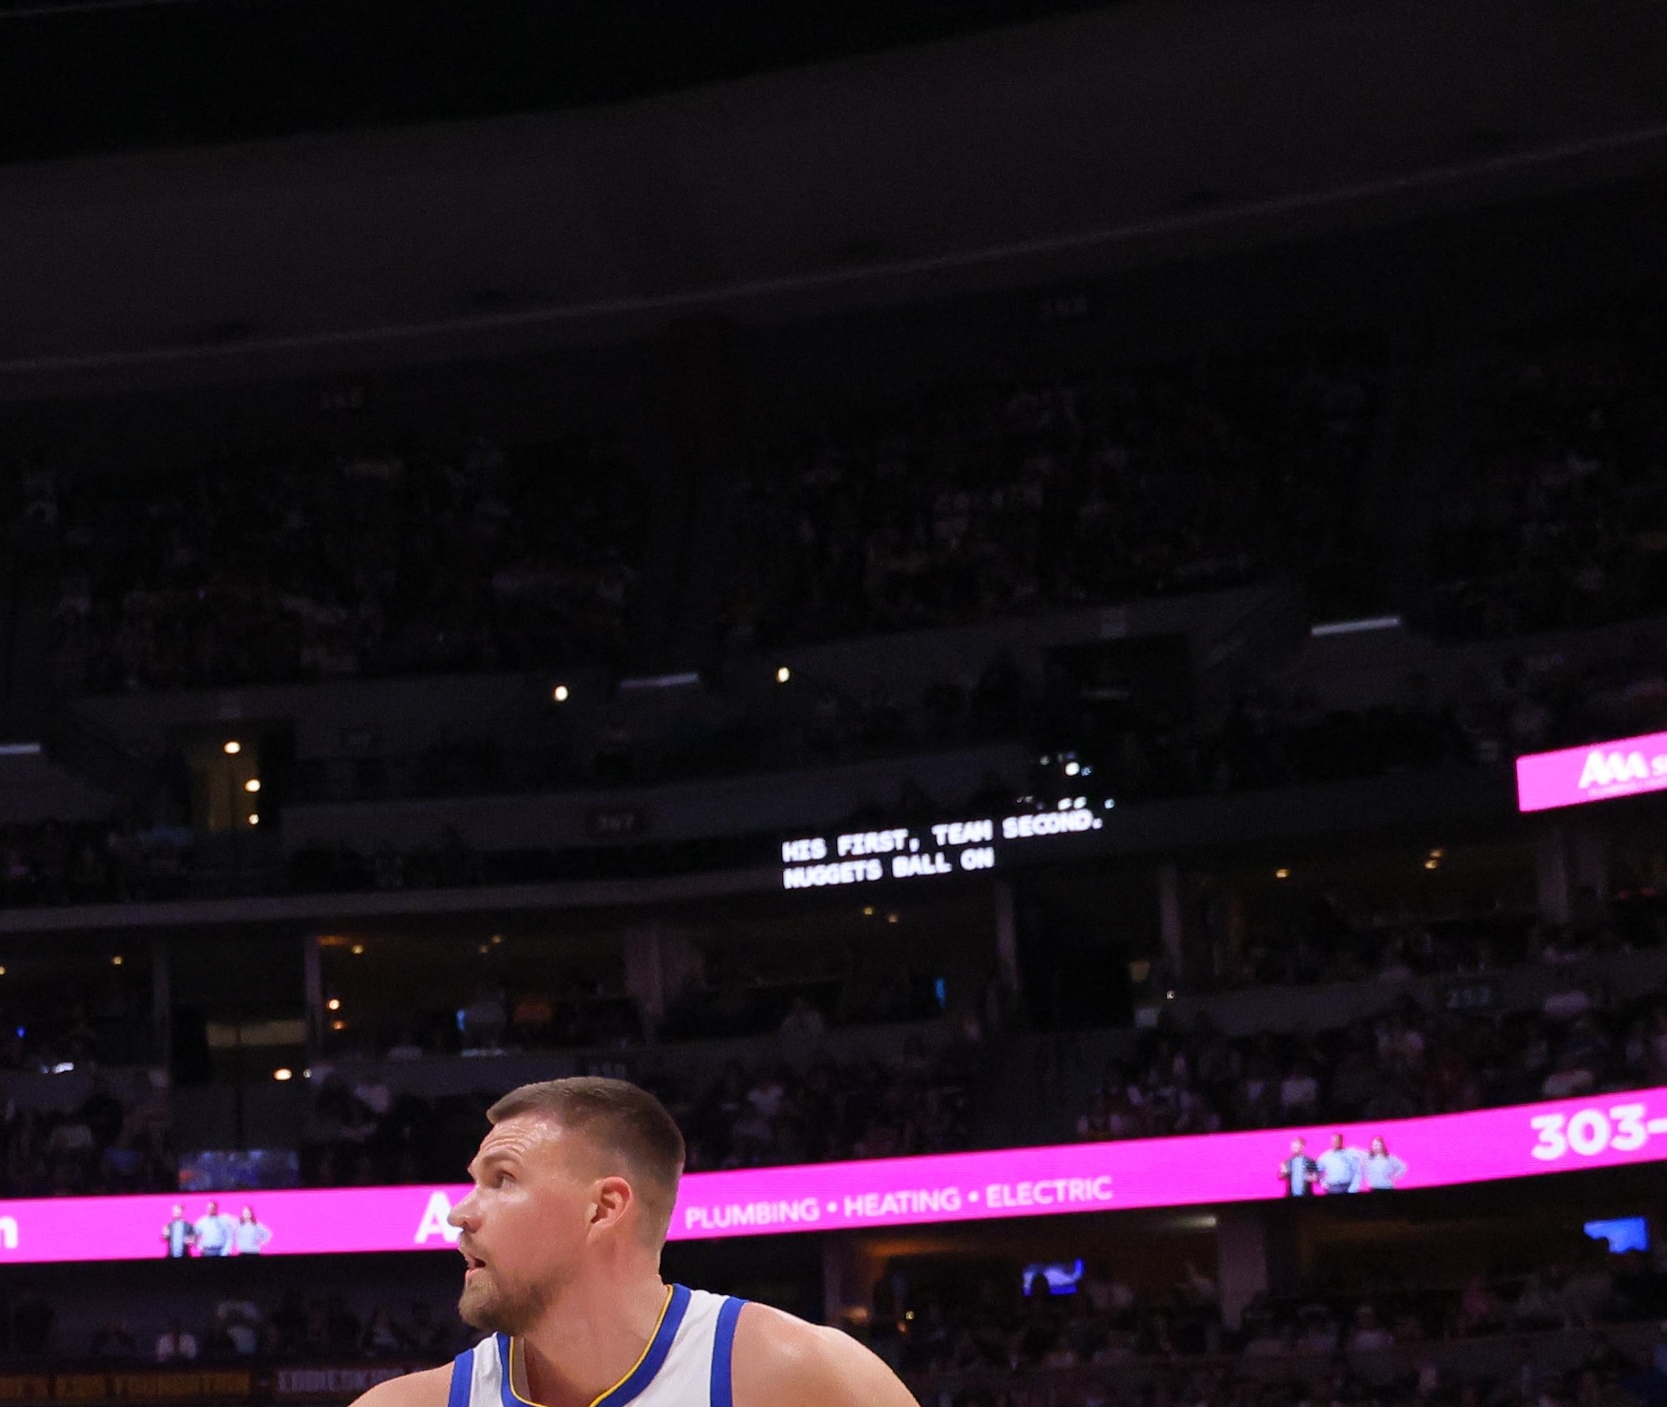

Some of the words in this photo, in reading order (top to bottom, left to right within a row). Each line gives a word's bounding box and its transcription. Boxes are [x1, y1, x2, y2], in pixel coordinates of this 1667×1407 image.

[1578, 749, 1649, 789] AAA
[837, 828, 920, 858] FIRST,
[931, 819, 994, 847] TEAM
[1002, 808, 1103, 839] SECOND.
[783, 858, 883, 889] NUGGETS
[892, 853, 952, 879] BALL
[960, 847, 995, 872] ON
[684, 1199, 820, 1231] PLUMBING
[843, 1186, 962, 1219] HEATING
[985, 1176, 1113, 1209] ELECTRIC
